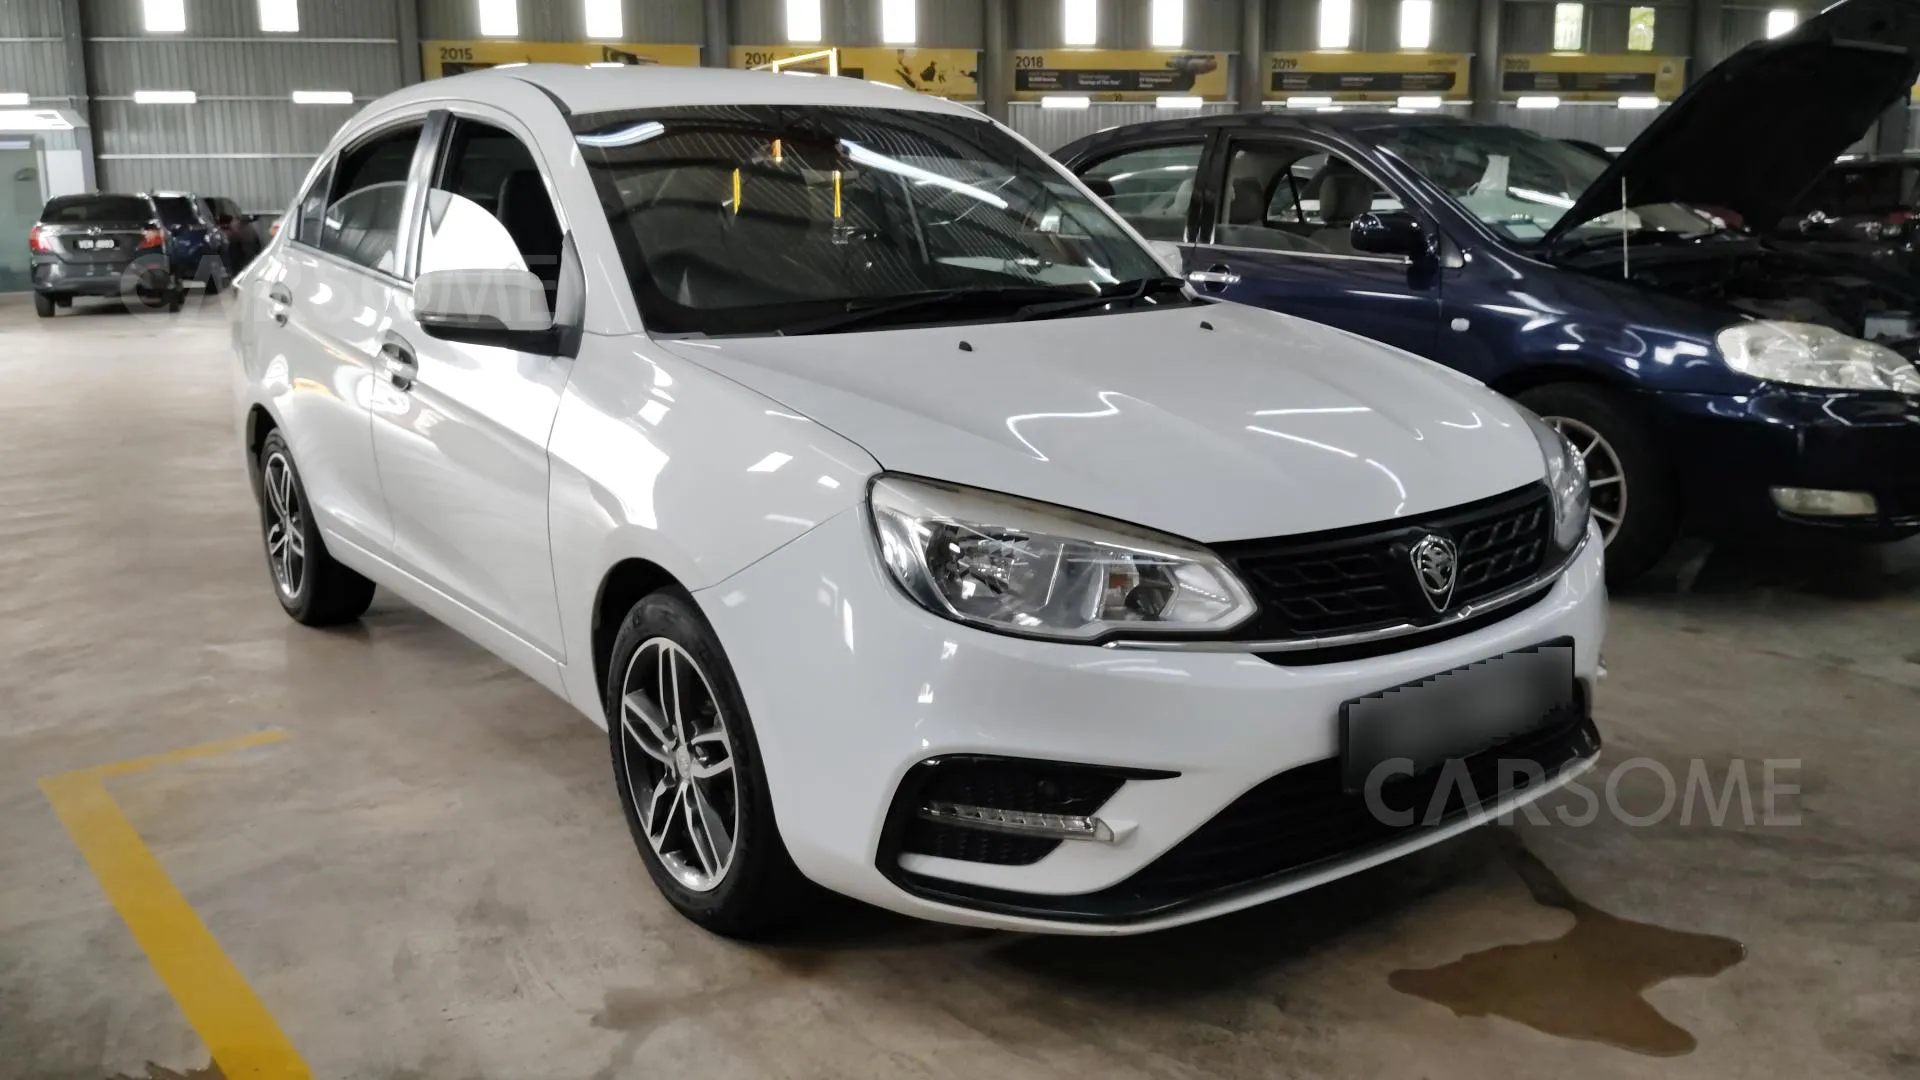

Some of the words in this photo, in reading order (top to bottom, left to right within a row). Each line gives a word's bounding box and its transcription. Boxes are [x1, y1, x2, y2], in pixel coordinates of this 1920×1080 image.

[440, 47, 473, 60] 2015
[1015, 56, 1044, 68] 2018
[1271, 58, 1298, 70] 2019
